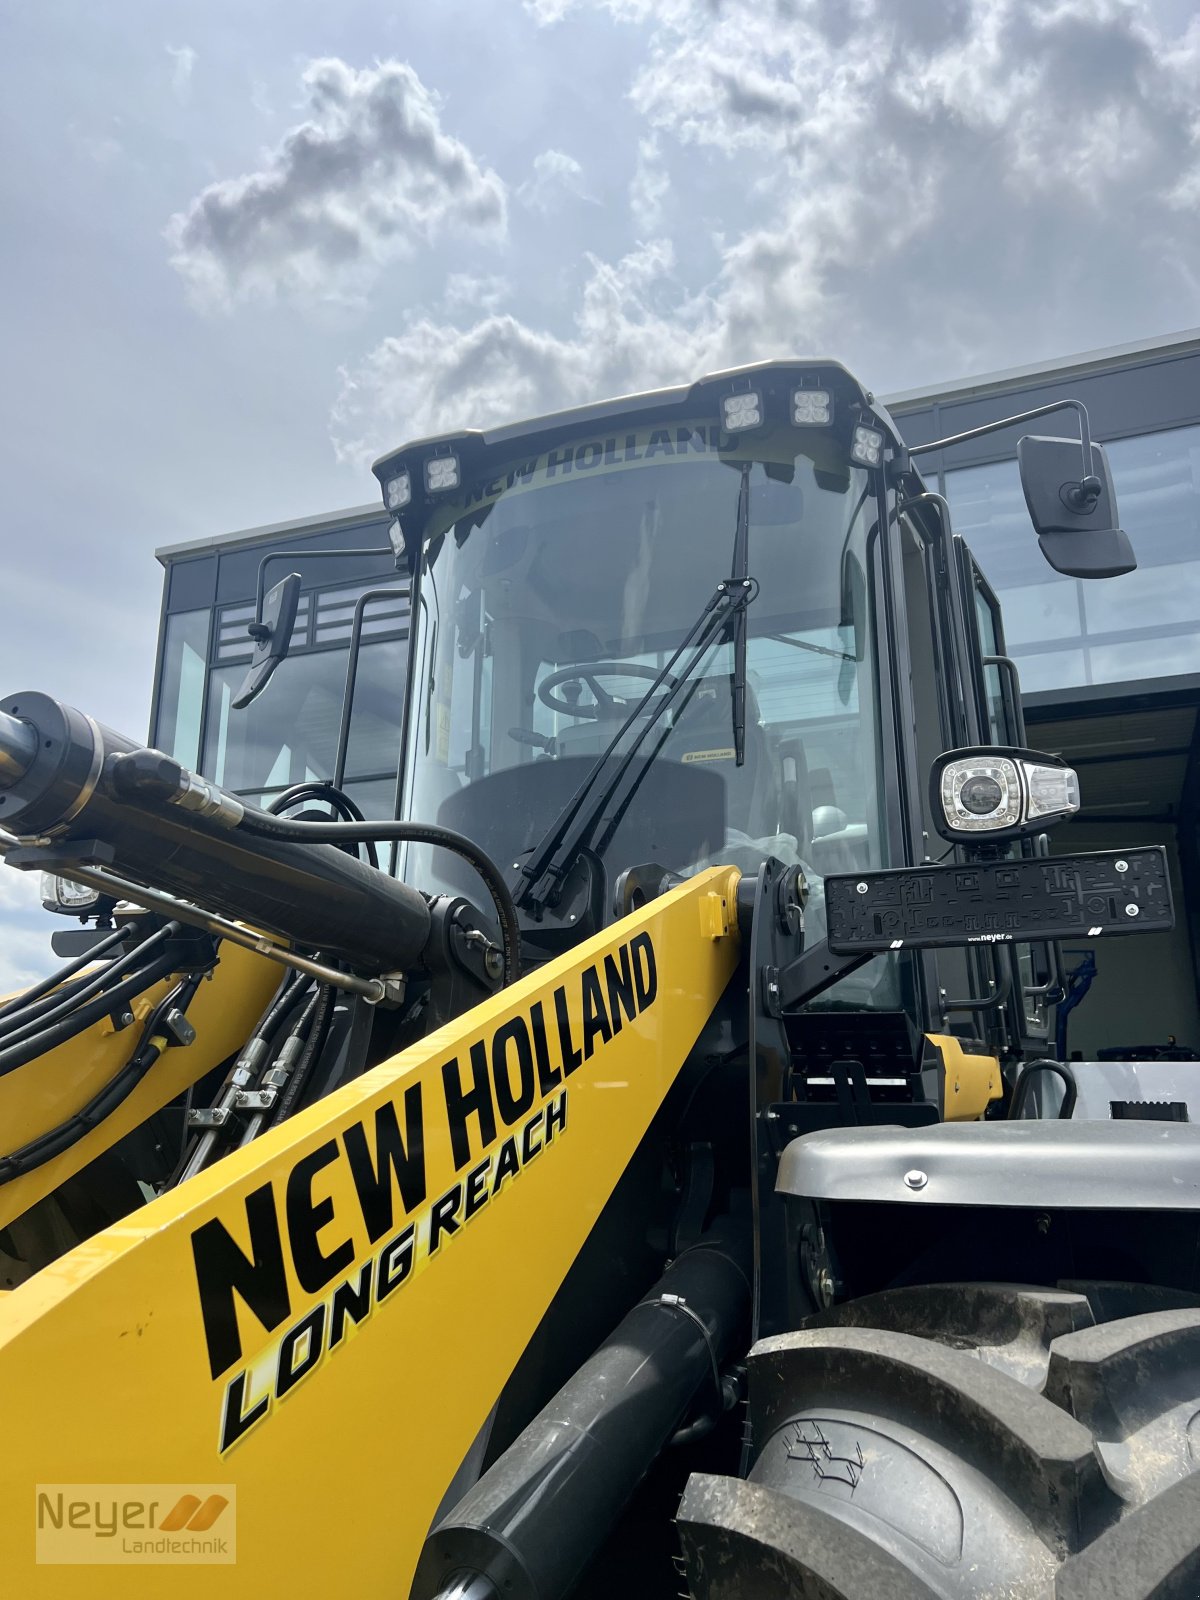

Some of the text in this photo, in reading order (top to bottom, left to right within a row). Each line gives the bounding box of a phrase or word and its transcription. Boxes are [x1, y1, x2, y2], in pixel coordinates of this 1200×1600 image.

[463, 425, 740, 509] NEW HOLLAND
[968, 933, 1013, 942] www.neyer.de
[190, 930, 658, 1380] NEW HOLLAND
[218, 1089, 568, 1456] LONG REACH
